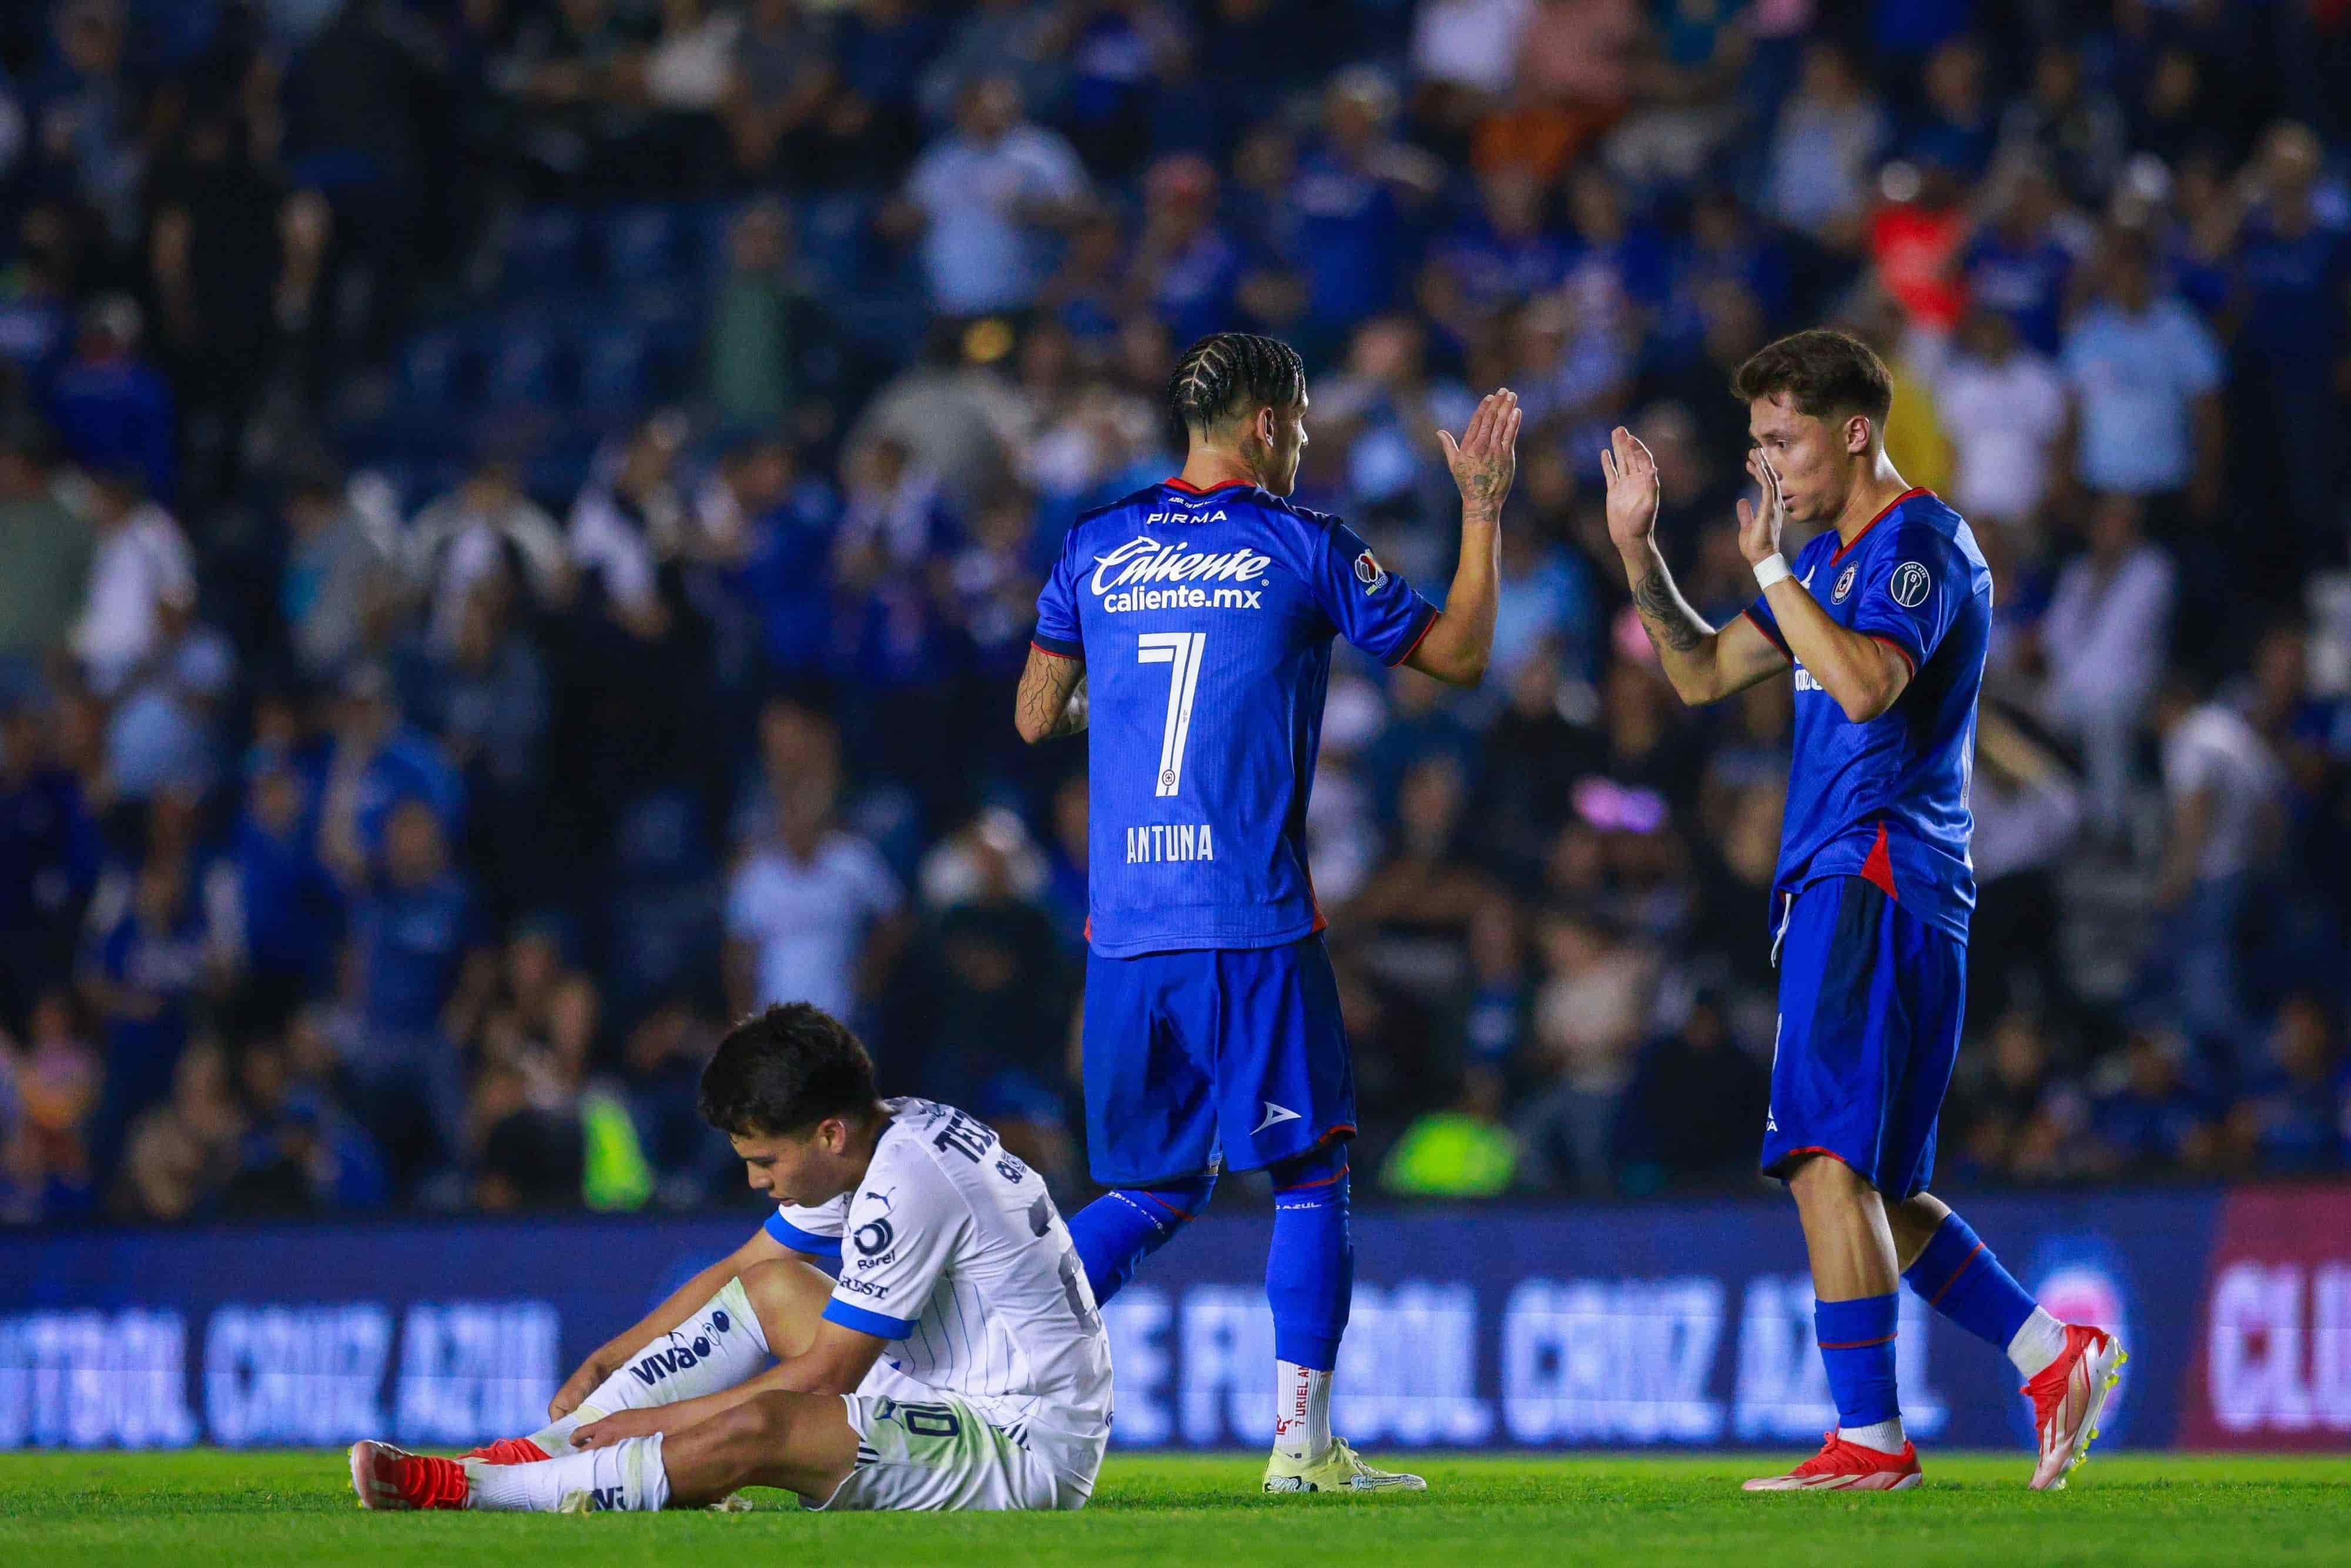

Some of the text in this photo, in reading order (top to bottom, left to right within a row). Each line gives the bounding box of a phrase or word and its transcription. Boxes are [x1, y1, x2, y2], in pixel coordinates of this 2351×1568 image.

[1146, 510, 1228, 525] PIRMA
[1091, 535, 1271, 597] Caliente
[1103, 585, 1262, 614] caliente.mx
[1138, 632, 1207, 798] 7
[1126, 824, 1214, 864] ANTUNA
[1295, 1382, 1309, 1417] URIEL
